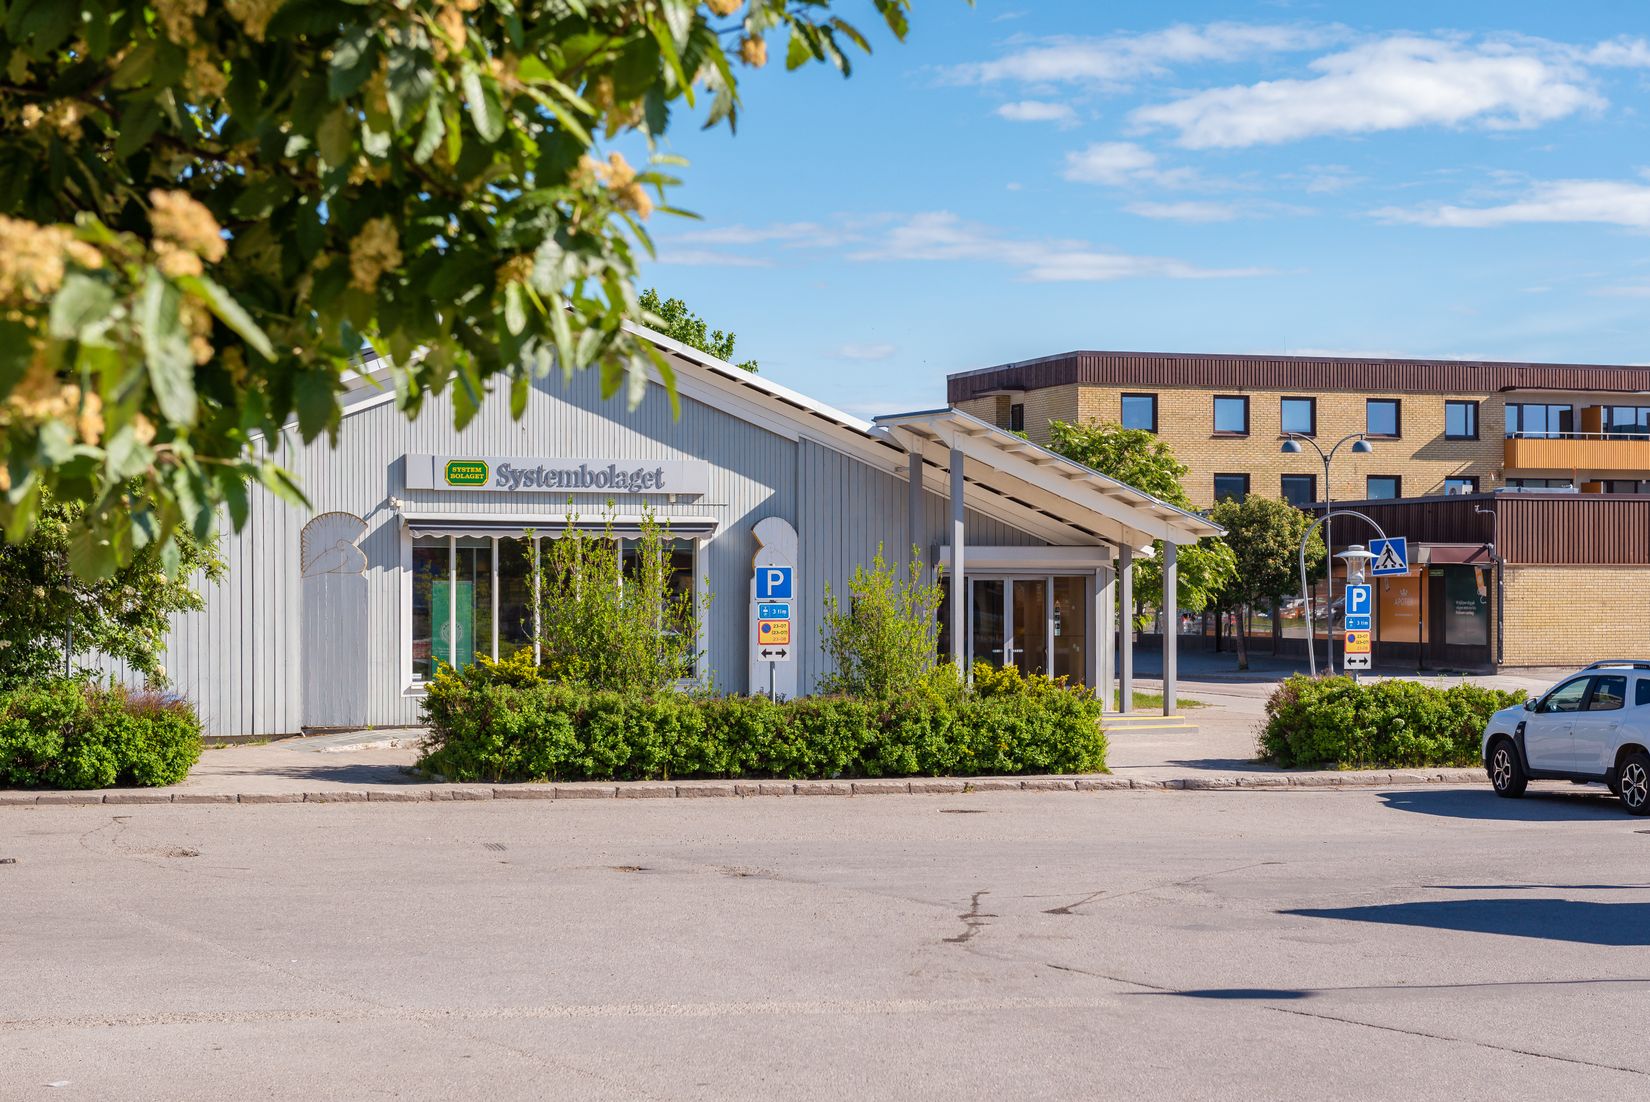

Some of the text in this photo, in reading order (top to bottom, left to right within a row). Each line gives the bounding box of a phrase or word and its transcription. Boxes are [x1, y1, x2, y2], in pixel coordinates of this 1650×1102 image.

[496, 463, 665, 492] Systembolaget
[767, 570, 784, 595] P
[1352, 588, 1367, 612] P
